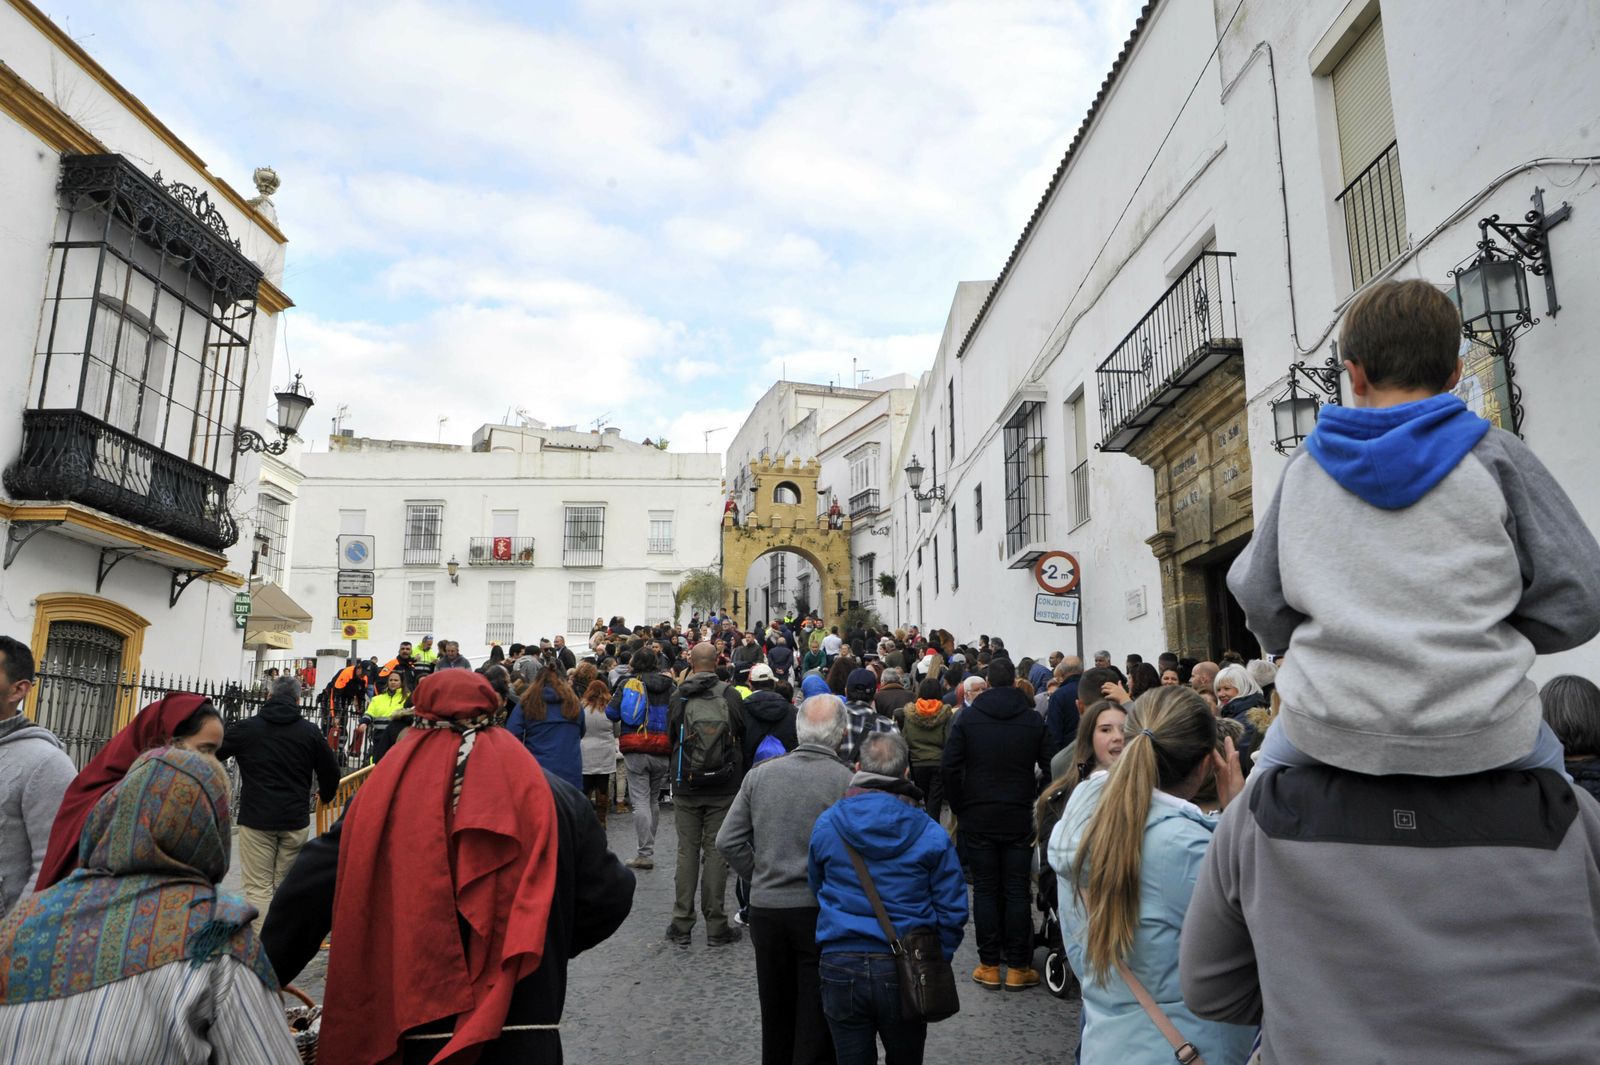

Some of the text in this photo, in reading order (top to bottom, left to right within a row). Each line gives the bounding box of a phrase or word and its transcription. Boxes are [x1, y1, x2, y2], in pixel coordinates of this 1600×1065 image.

[1048, 564, 1058, 579] 2
[1038, 597, 1071, 608] CONJUNTO
[235, 604, 248, 612] EXIT
[1036, 611, 1070, 620] HISTORICO
